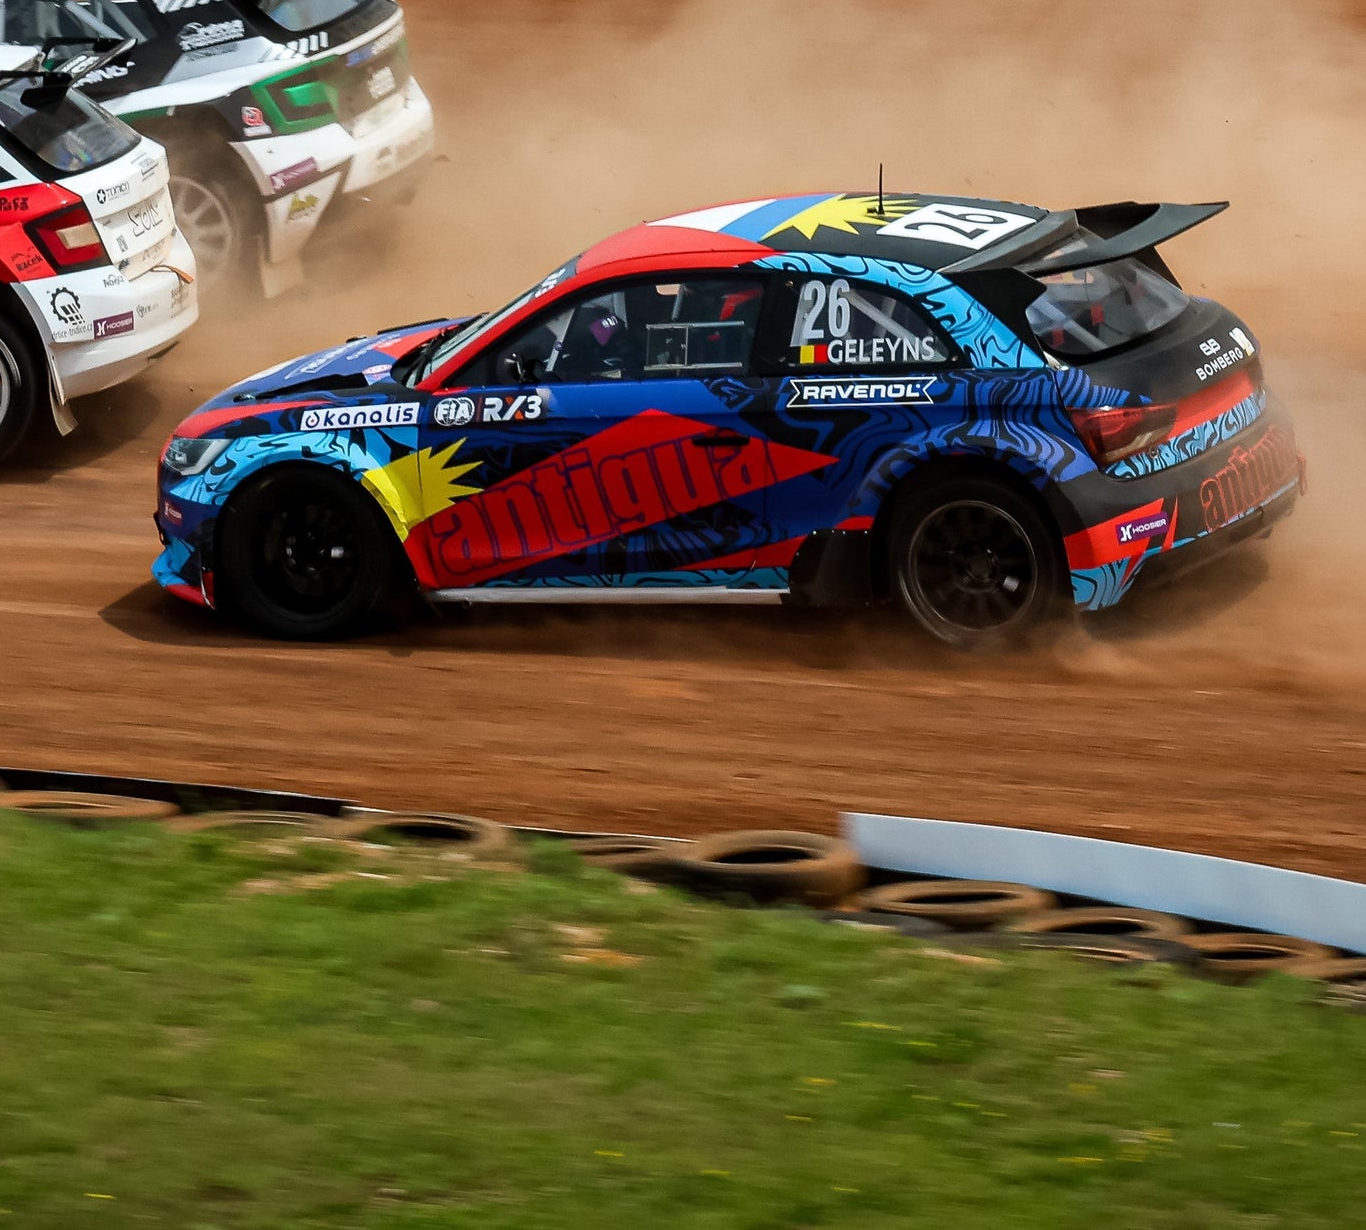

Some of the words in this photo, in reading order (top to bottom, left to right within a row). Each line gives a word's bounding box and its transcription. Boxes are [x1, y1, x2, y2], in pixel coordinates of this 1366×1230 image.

[800, 278, 852, 340] 26
[828, 336, 934, 365] GELEYNS
[803, 383, 923, 401] RAVENOL
[323, 405, 415, 428] kanalis
[435, 400, 471, 423] FIA
[483, 395, 542, 422] RX3
[434, 437, 779, 574] antigua
[1132, 518, 1167, 535] HOOSIER
